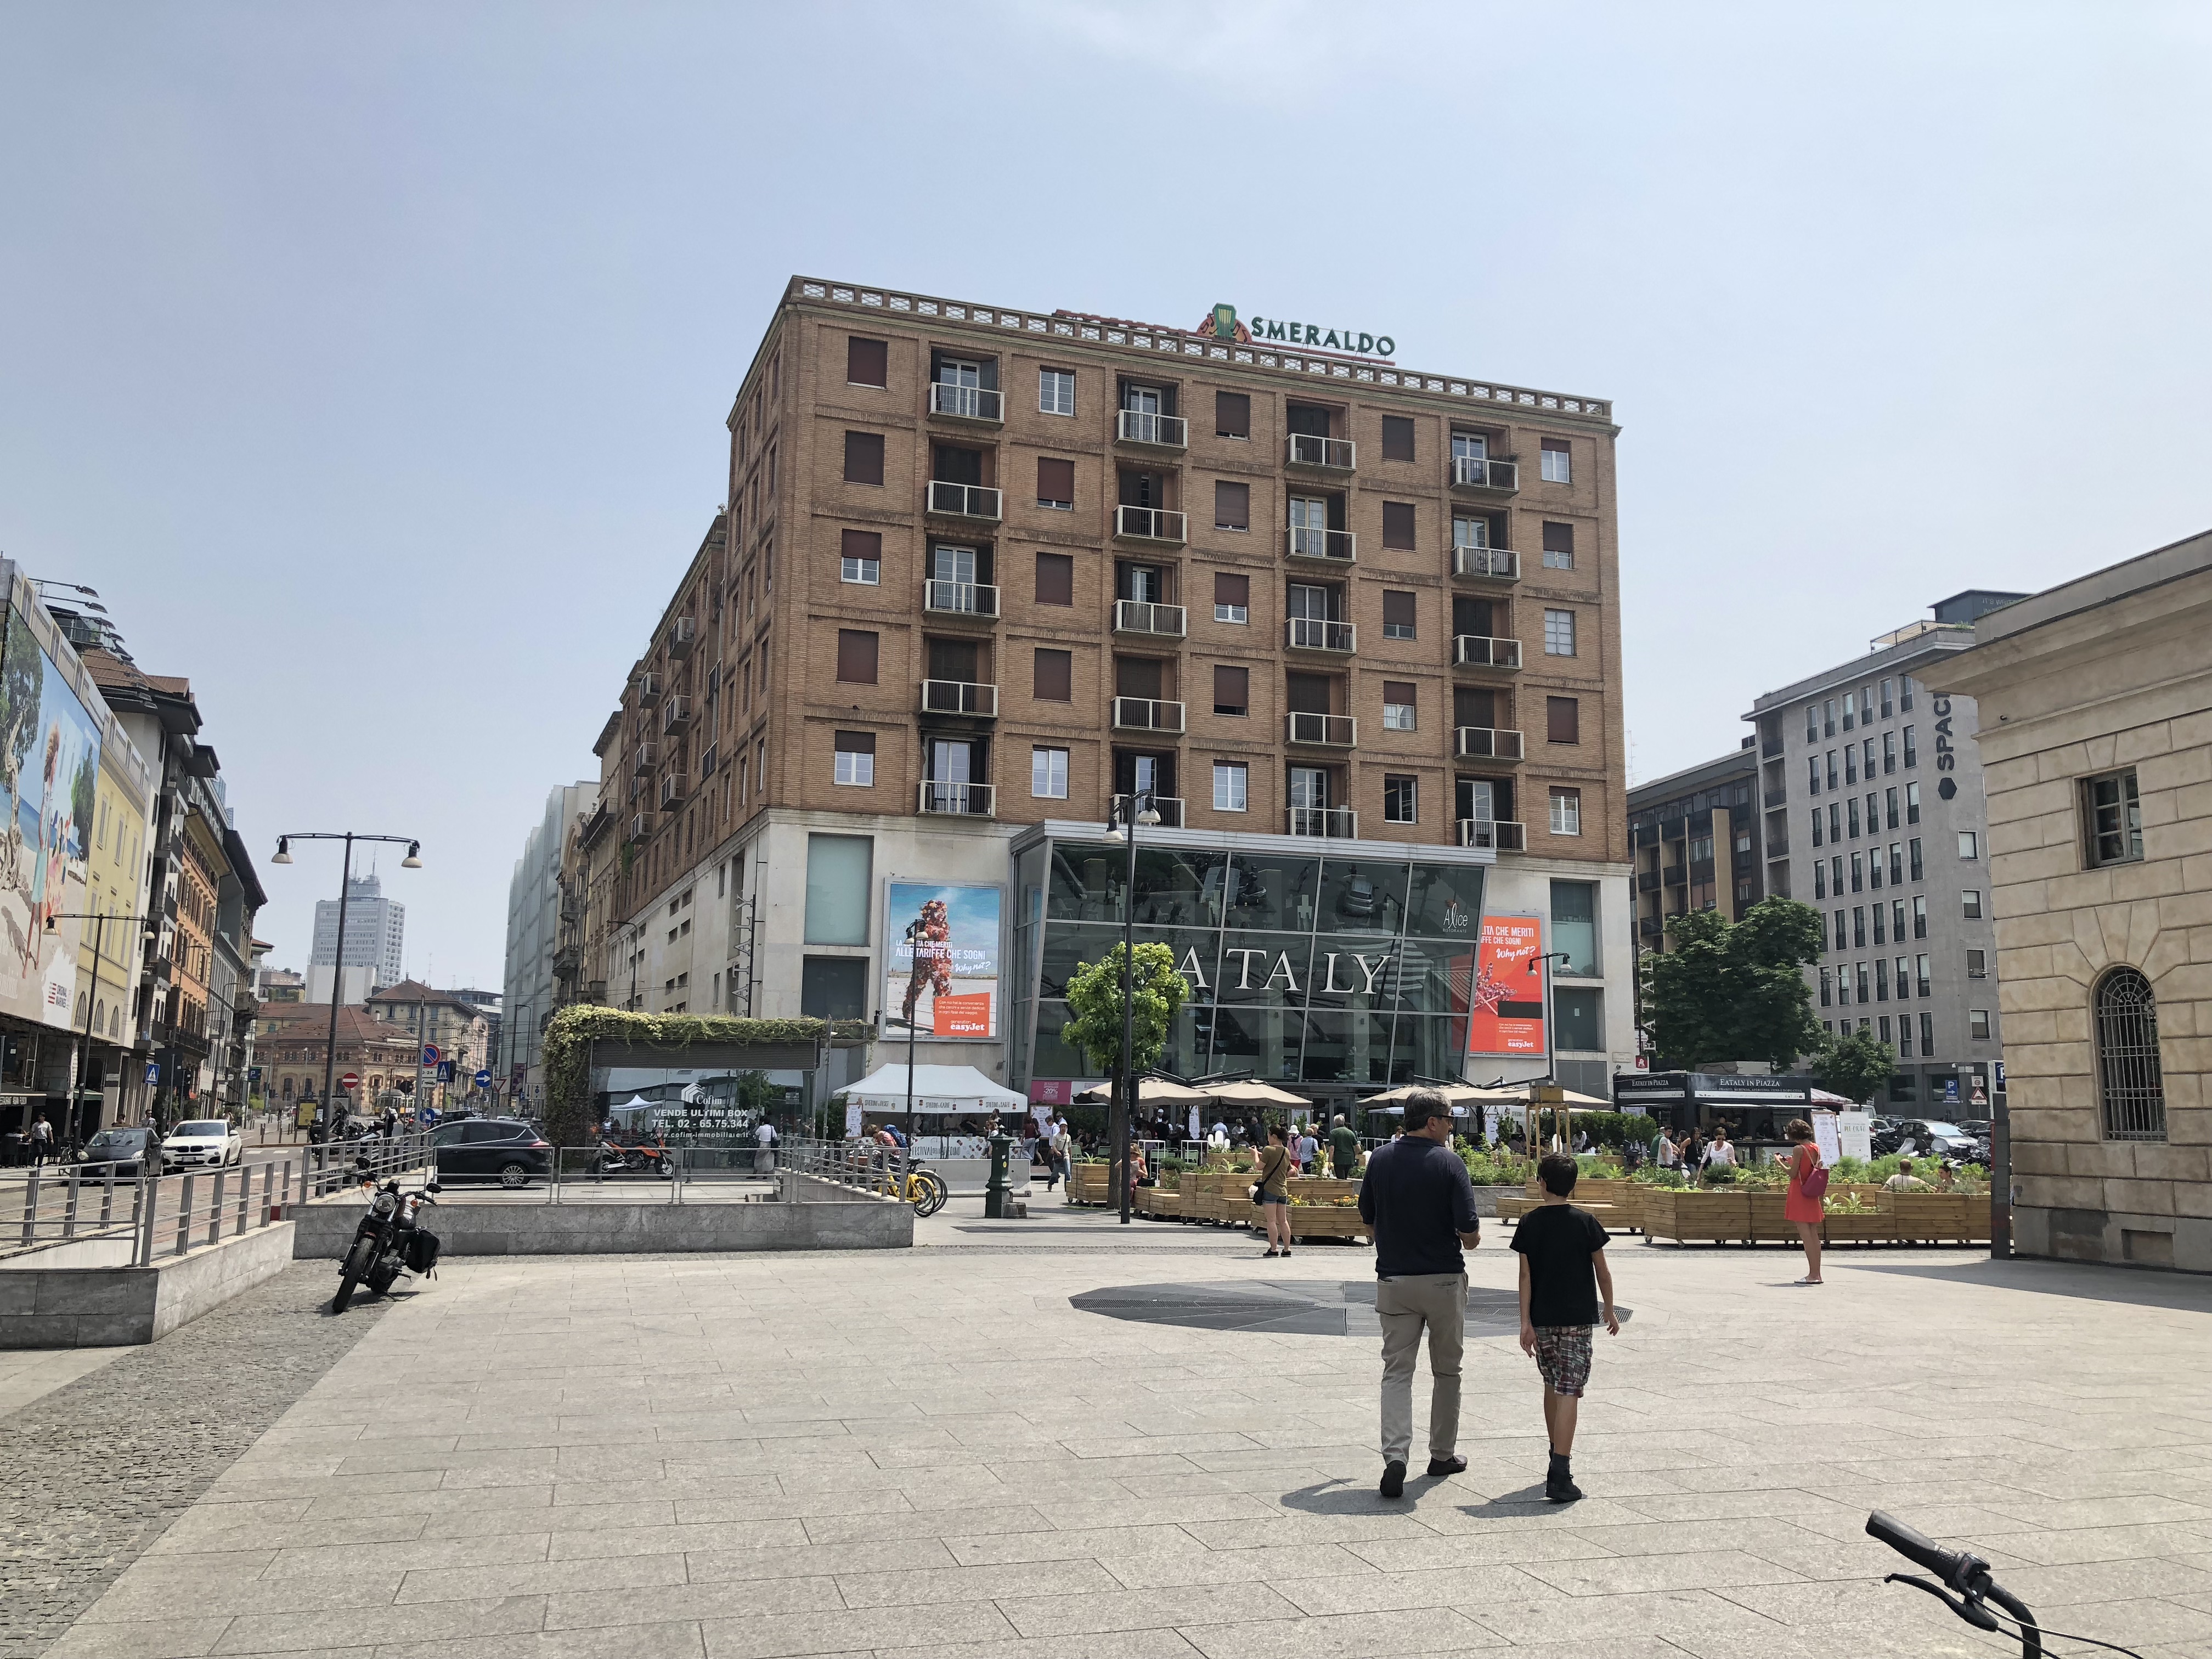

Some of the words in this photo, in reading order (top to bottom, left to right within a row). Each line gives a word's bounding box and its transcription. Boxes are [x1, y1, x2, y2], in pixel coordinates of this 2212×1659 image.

[1251, 316, 1396, 356] SMERALDO
[1443, 902, 1468, 928] Alice
[1496, 926, 1509, 936] CHE
[1511, 927, 1534, 938] MERITI
[1493, 936, 1504, 945] CHE
[1505, 937, 1521, 945] SOGNI
[731, 893, 753, 1017] ATALY
[895, 947, 913, 957] ALLE
[916, 948, 945, 959] TARIFFE
[946, 949, 961, 960] CHE
[963, 950, 986, 960] SOGNI
[1496, 947, 1515, 962] Why
[1516, 945, 1536, 956] not?
[955, 963, 973, 974] Why
[973, 961, 991, 970] not?
[1179, 945, 1394, 995] ATALY
[950, 1023, 985, 1032] easyJet
[696, 1095, 723, 1104] Cofim
[652, 1119, 674, 1128] TEL.
[678, 1119, 690, 1128] 02
[699, 1119, 748, 1128] 65.75.344
[912, 1146, 933, 1156] FESTIVAL
